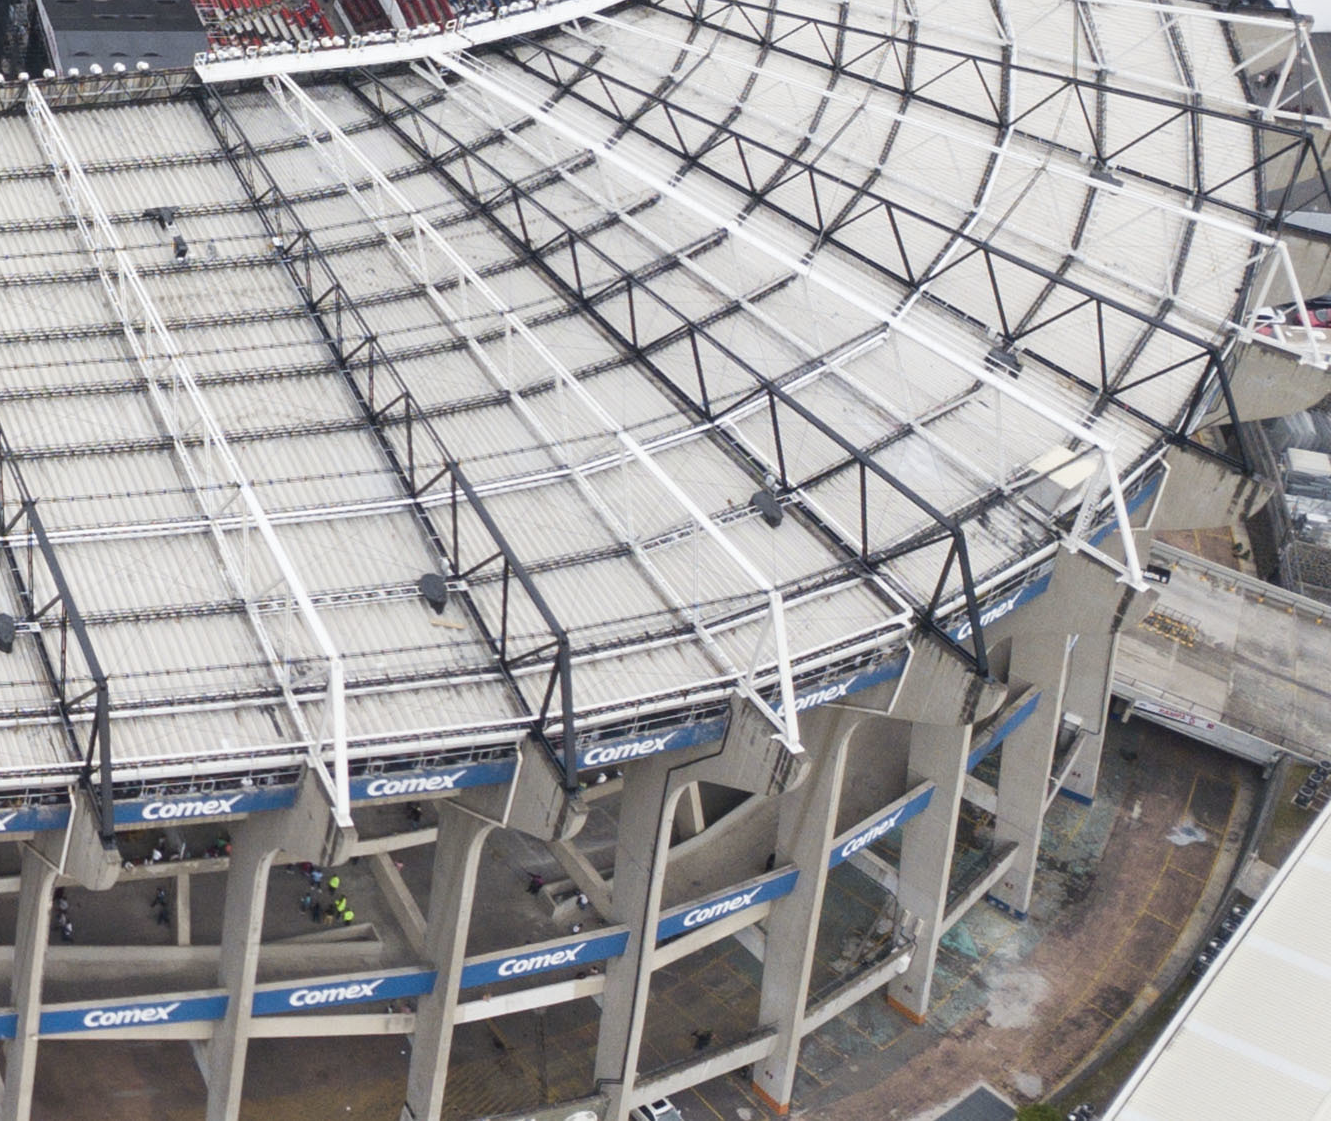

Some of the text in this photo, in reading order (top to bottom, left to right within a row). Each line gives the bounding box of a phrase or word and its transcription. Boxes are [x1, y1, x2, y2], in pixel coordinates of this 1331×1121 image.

[583, 732, 678, 767] Comex
[366, 769, 467, 797] Comex
[141, 794, 244, 819] Comex
[839, 807, 905, 859] Comex
[683, 886, 763, 927] Comex
[498, 943, 587, 978] Comex
[289, 979, 383, 1007] Comex
[83, 1002, 181, 1028] Comex
